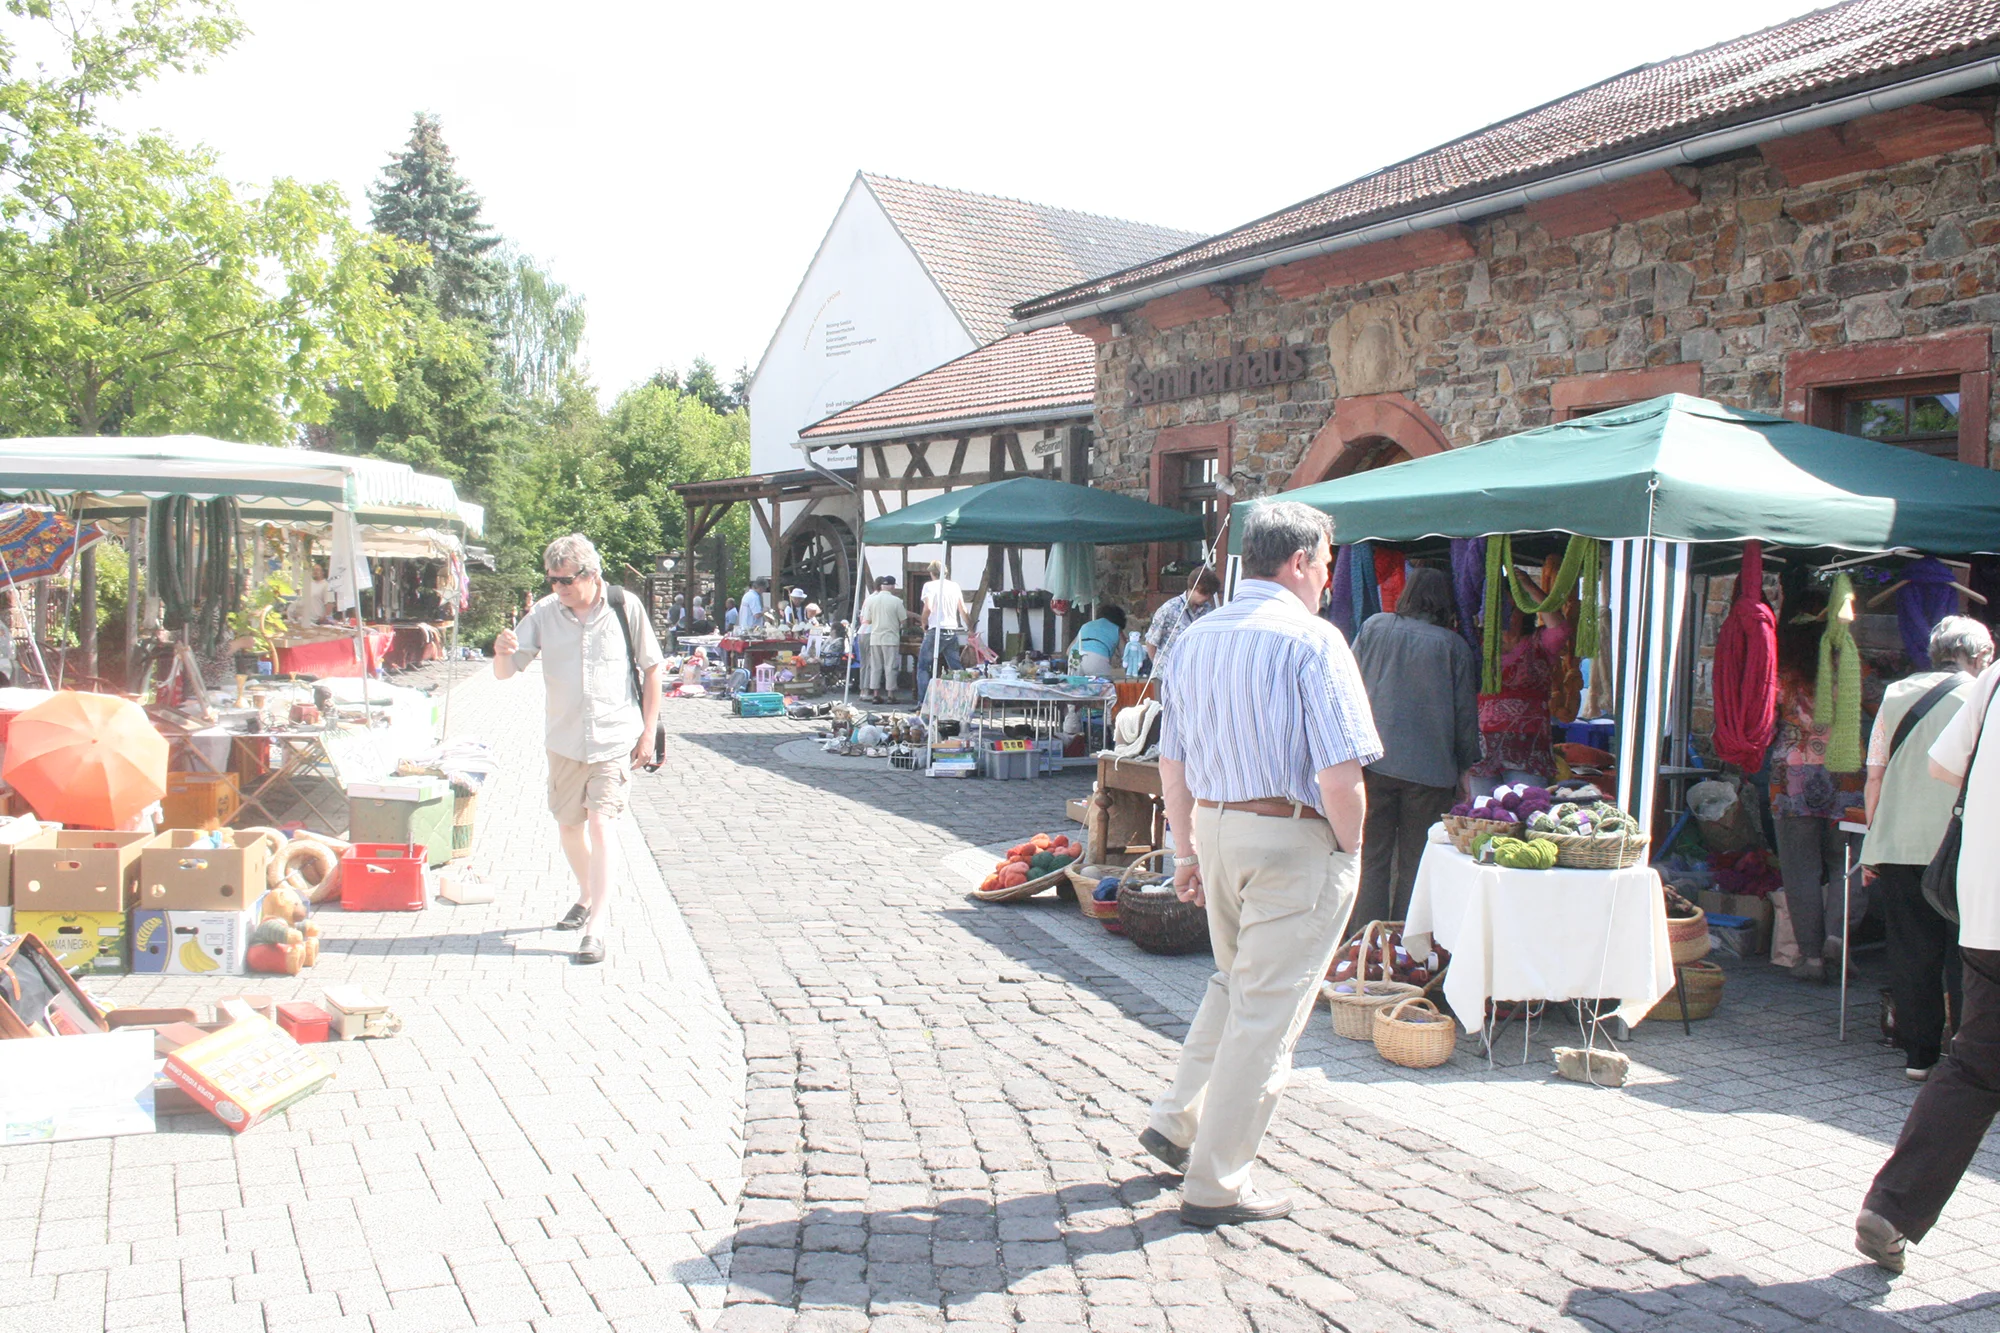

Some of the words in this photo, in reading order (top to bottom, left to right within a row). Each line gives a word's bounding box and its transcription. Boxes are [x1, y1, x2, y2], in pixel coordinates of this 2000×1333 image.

[1125, 341, 1306, 406] Seminarhaus
[44, 938, 66, 950] MAMA
[67, 938, 93, 950] NEGRA
[227, 918, 235, 951] BANANAS
[226, 952, 234, 973] FRESH
